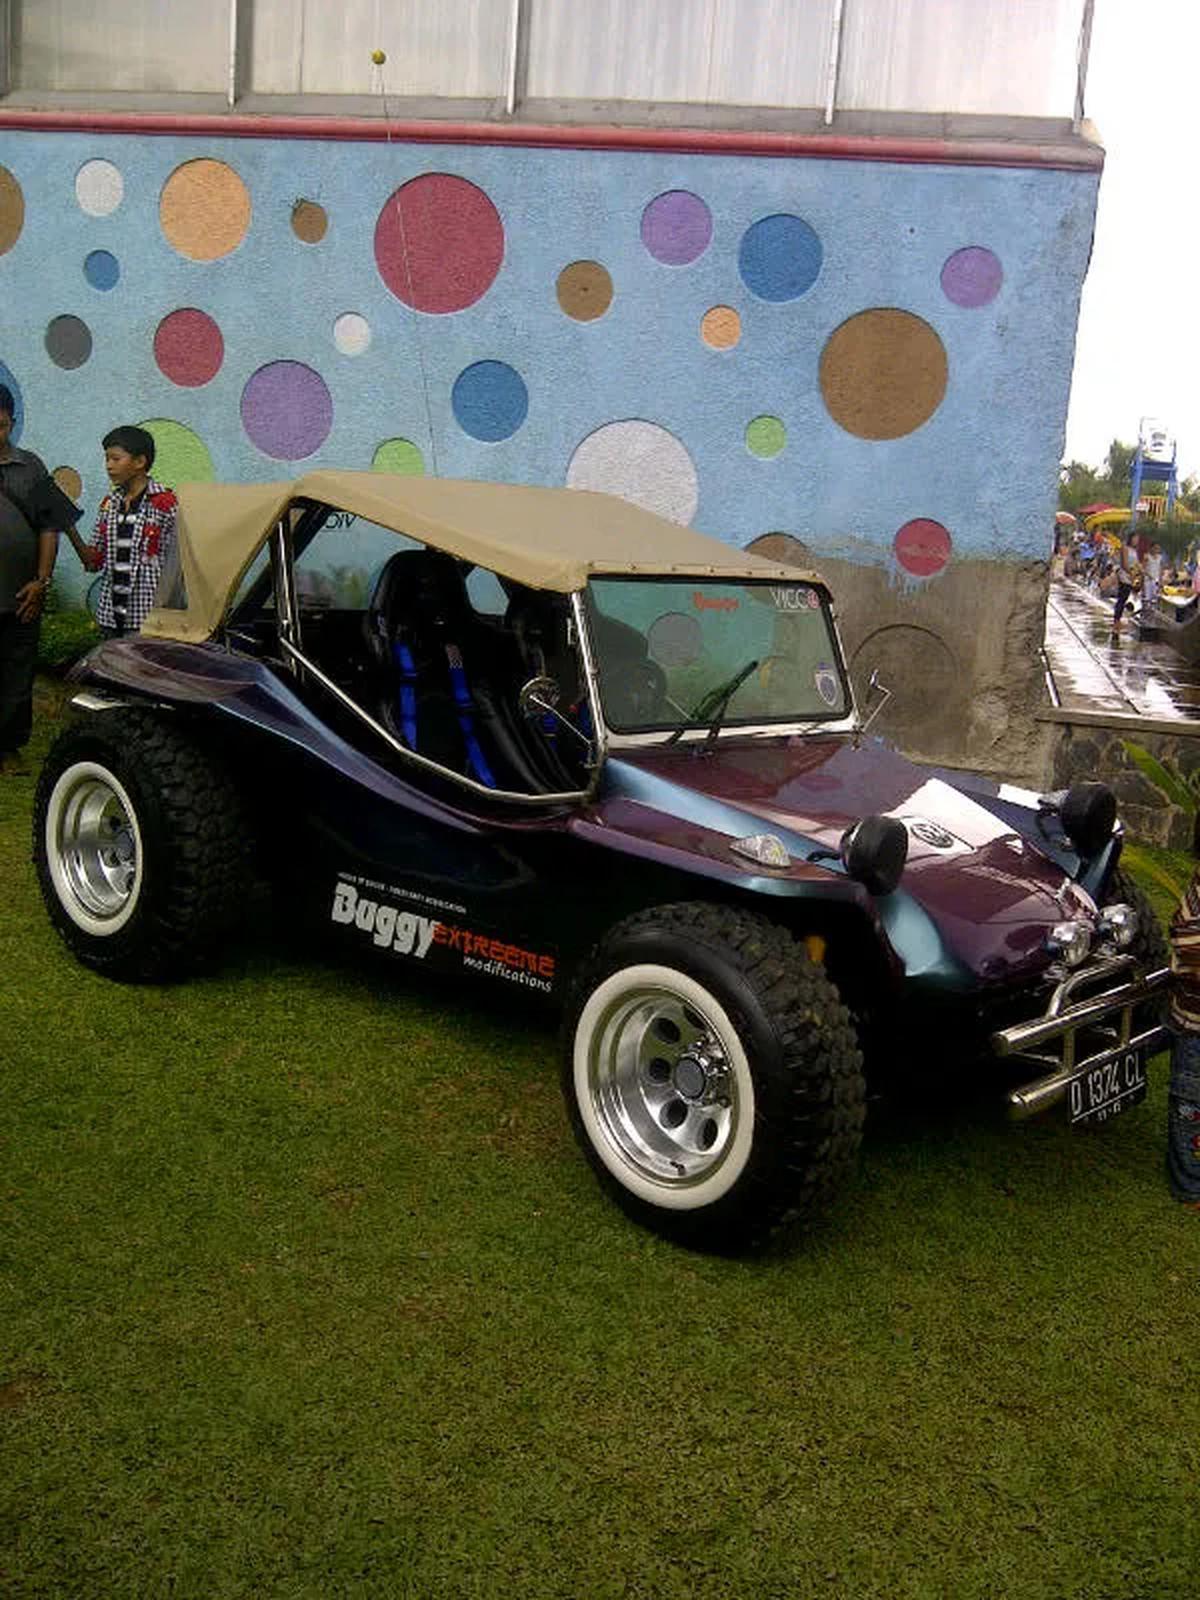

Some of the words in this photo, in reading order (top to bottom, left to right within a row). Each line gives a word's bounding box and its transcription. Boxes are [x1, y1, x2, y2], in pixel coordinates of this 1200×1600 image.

[331, 881, 441, 959] Buggy
[463, 955, 553, 993] modifications
[1071, 1081, 1082, 1116] D
[1087, 1060, 1120, 1107] 1374
[1125, 1051, 1145, 1088] CL
